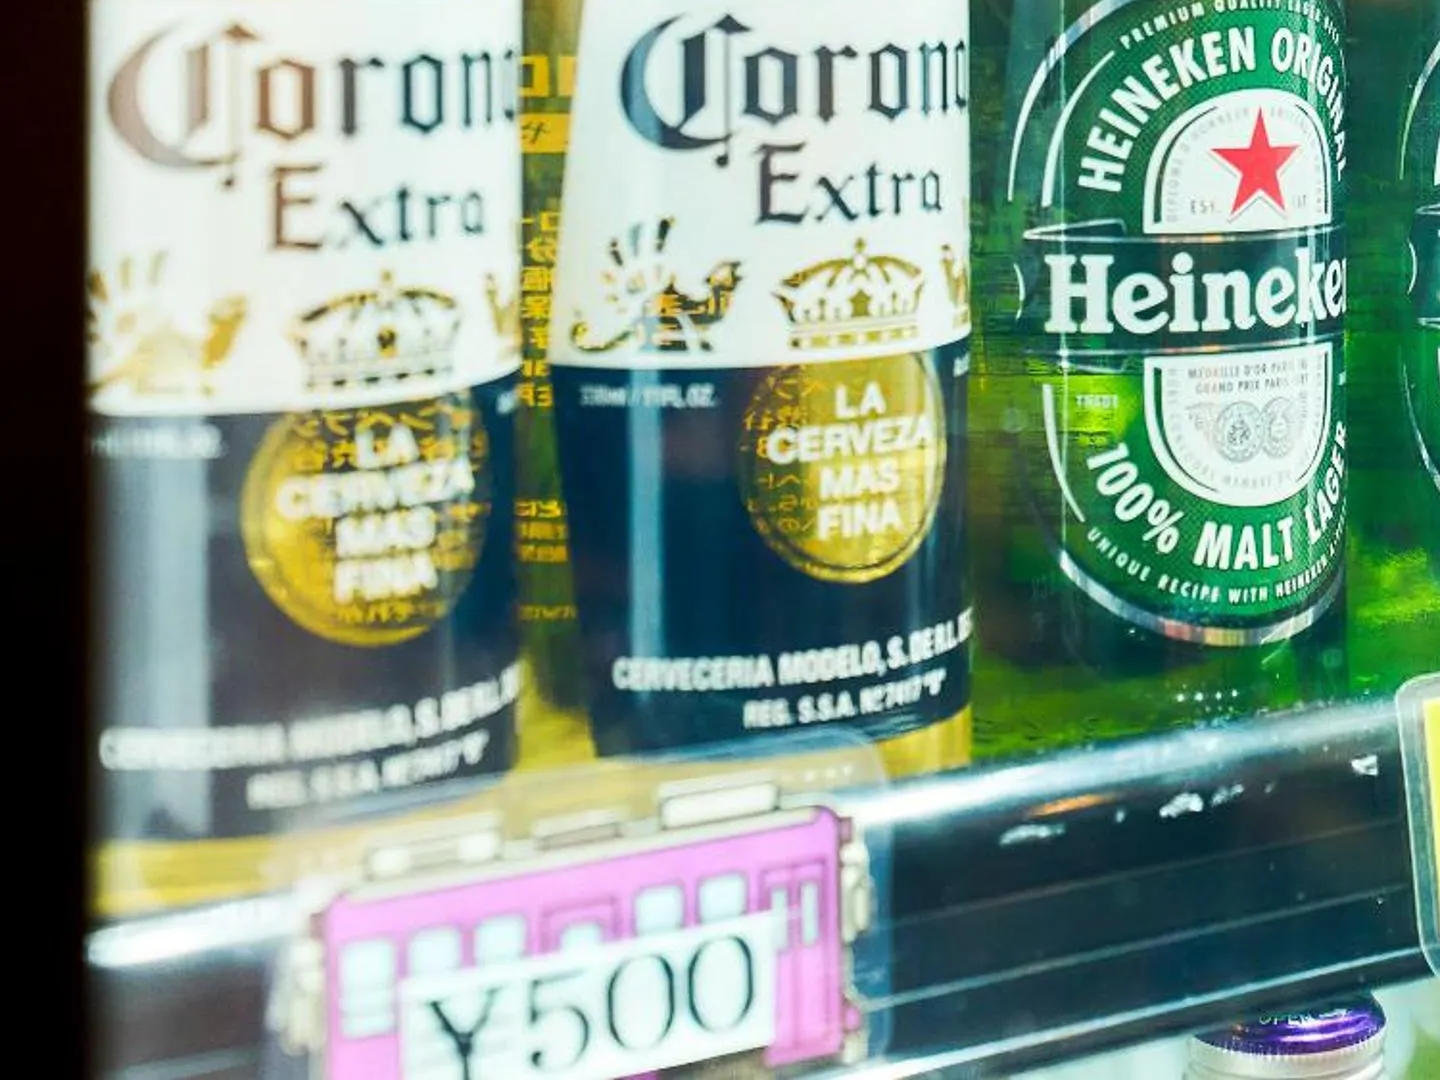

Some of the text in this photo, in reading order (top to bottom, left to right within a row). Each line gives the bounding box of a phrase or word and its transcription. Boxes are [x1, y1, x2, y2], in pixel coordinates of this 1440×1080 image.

[1119, 1, 1205, 50] PREMIUM
[1078, 26, 1257, 193] HEINEKEN
[270, 163, 485, 252] Extra
[753, 142, 943, 226] Extra
[1044, 247, 1347, 333] Heineke
[834, 382, 886, 418] LA
[354, 423, 420, 469] LA
[765, 413, 936, 465] CERVEZA
[818, 460, 900, 500] MAS
[1086, 442, 1185, 555] 100%
[1193, 516, 1294, 570] MALT
[1304, 420, 1347, 545] LAGER
[816, 498, 905, 542] FINA
[1086, 527, 1151, 581] UNIQUE
[1157, 575, 1220, 603] RECIPE
[1228, 584, 1268, 604] WITH
[612, 654, 775, 692] CERVECERIA
